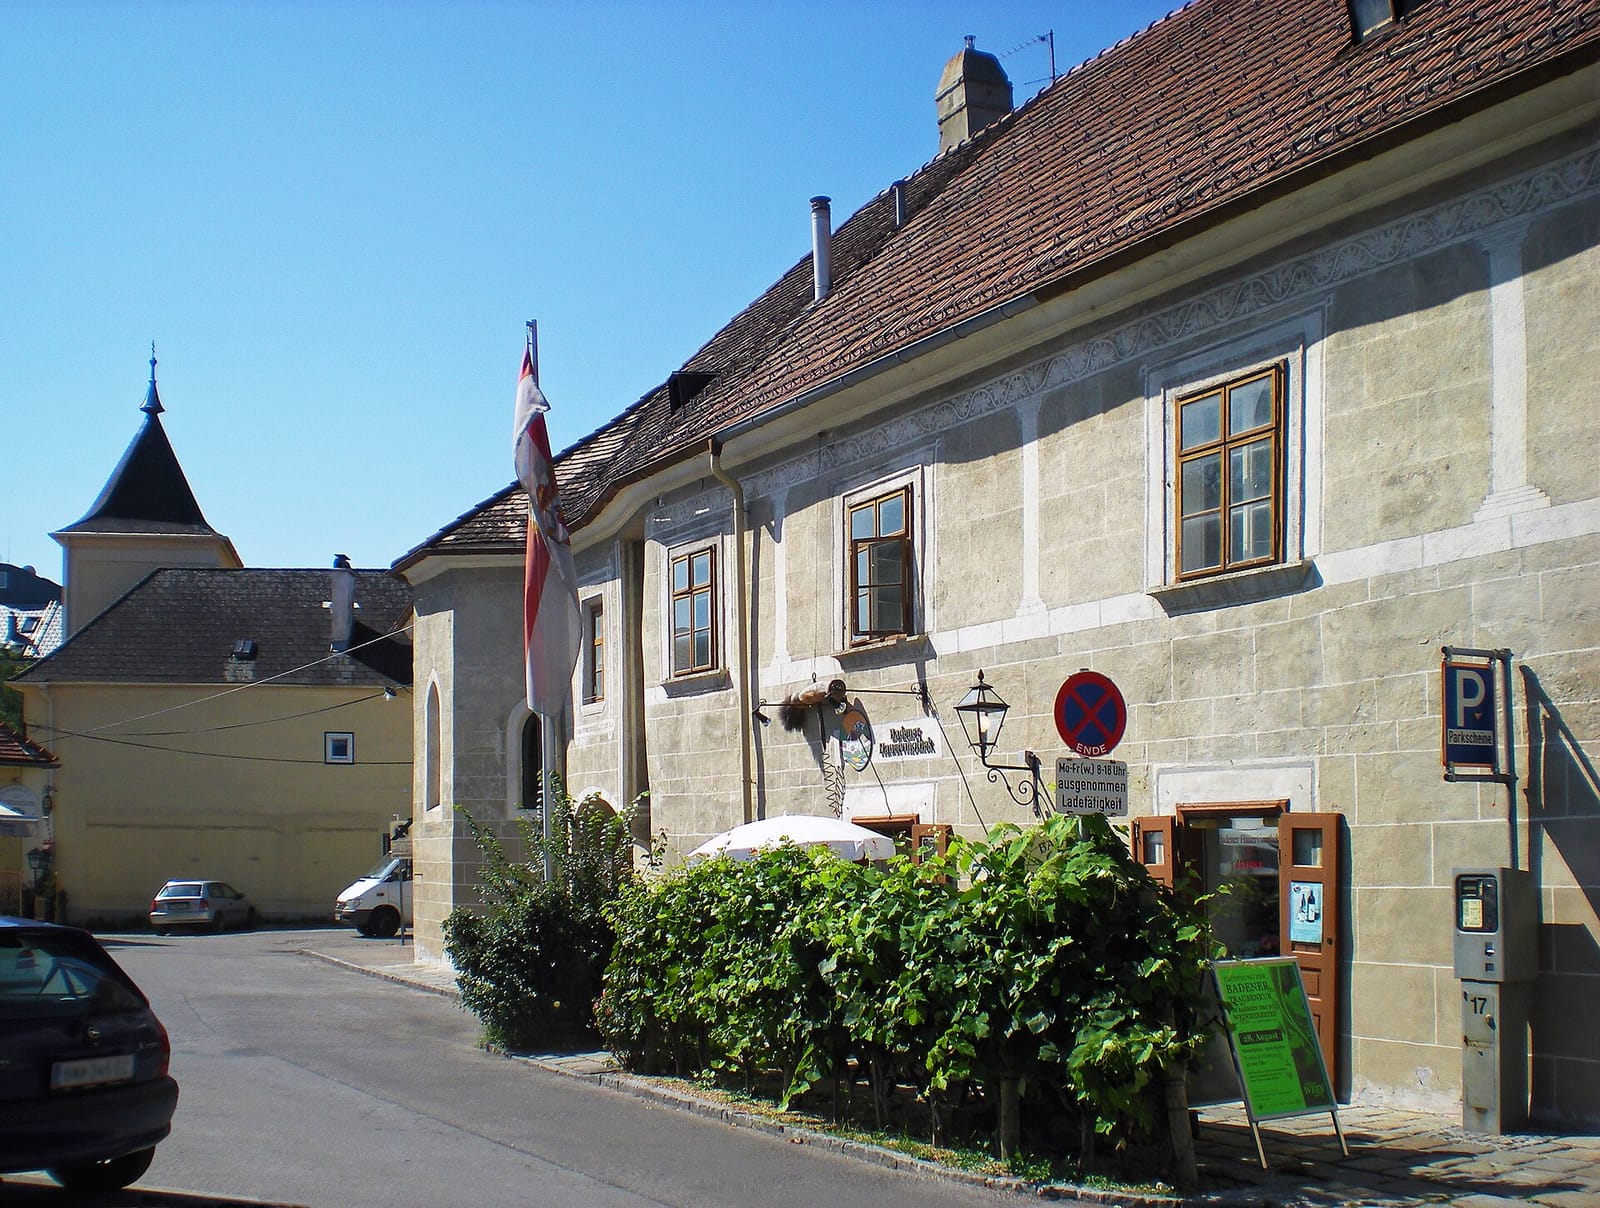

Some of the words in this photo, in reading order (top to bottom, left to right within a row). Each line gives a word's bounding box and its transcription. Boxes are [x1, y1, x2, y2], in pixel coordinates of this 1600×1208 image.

[1456, 669, 1486, 727] P
[1448, 730, 1492, 745] Parkscheine
[1076, 742, 1107, 756] ENDE
[1096, 764, 1112, 776] 8-18
[1113, 764, 1127, 777] Uhr
[1058, 779, 1126, 794] ausgenommen
[1062, 794, 1122, 812] Ladetätigkeit
[1225, 981, 1270, 993] BADENER
[1470, 997, 1487, 1015] 17
